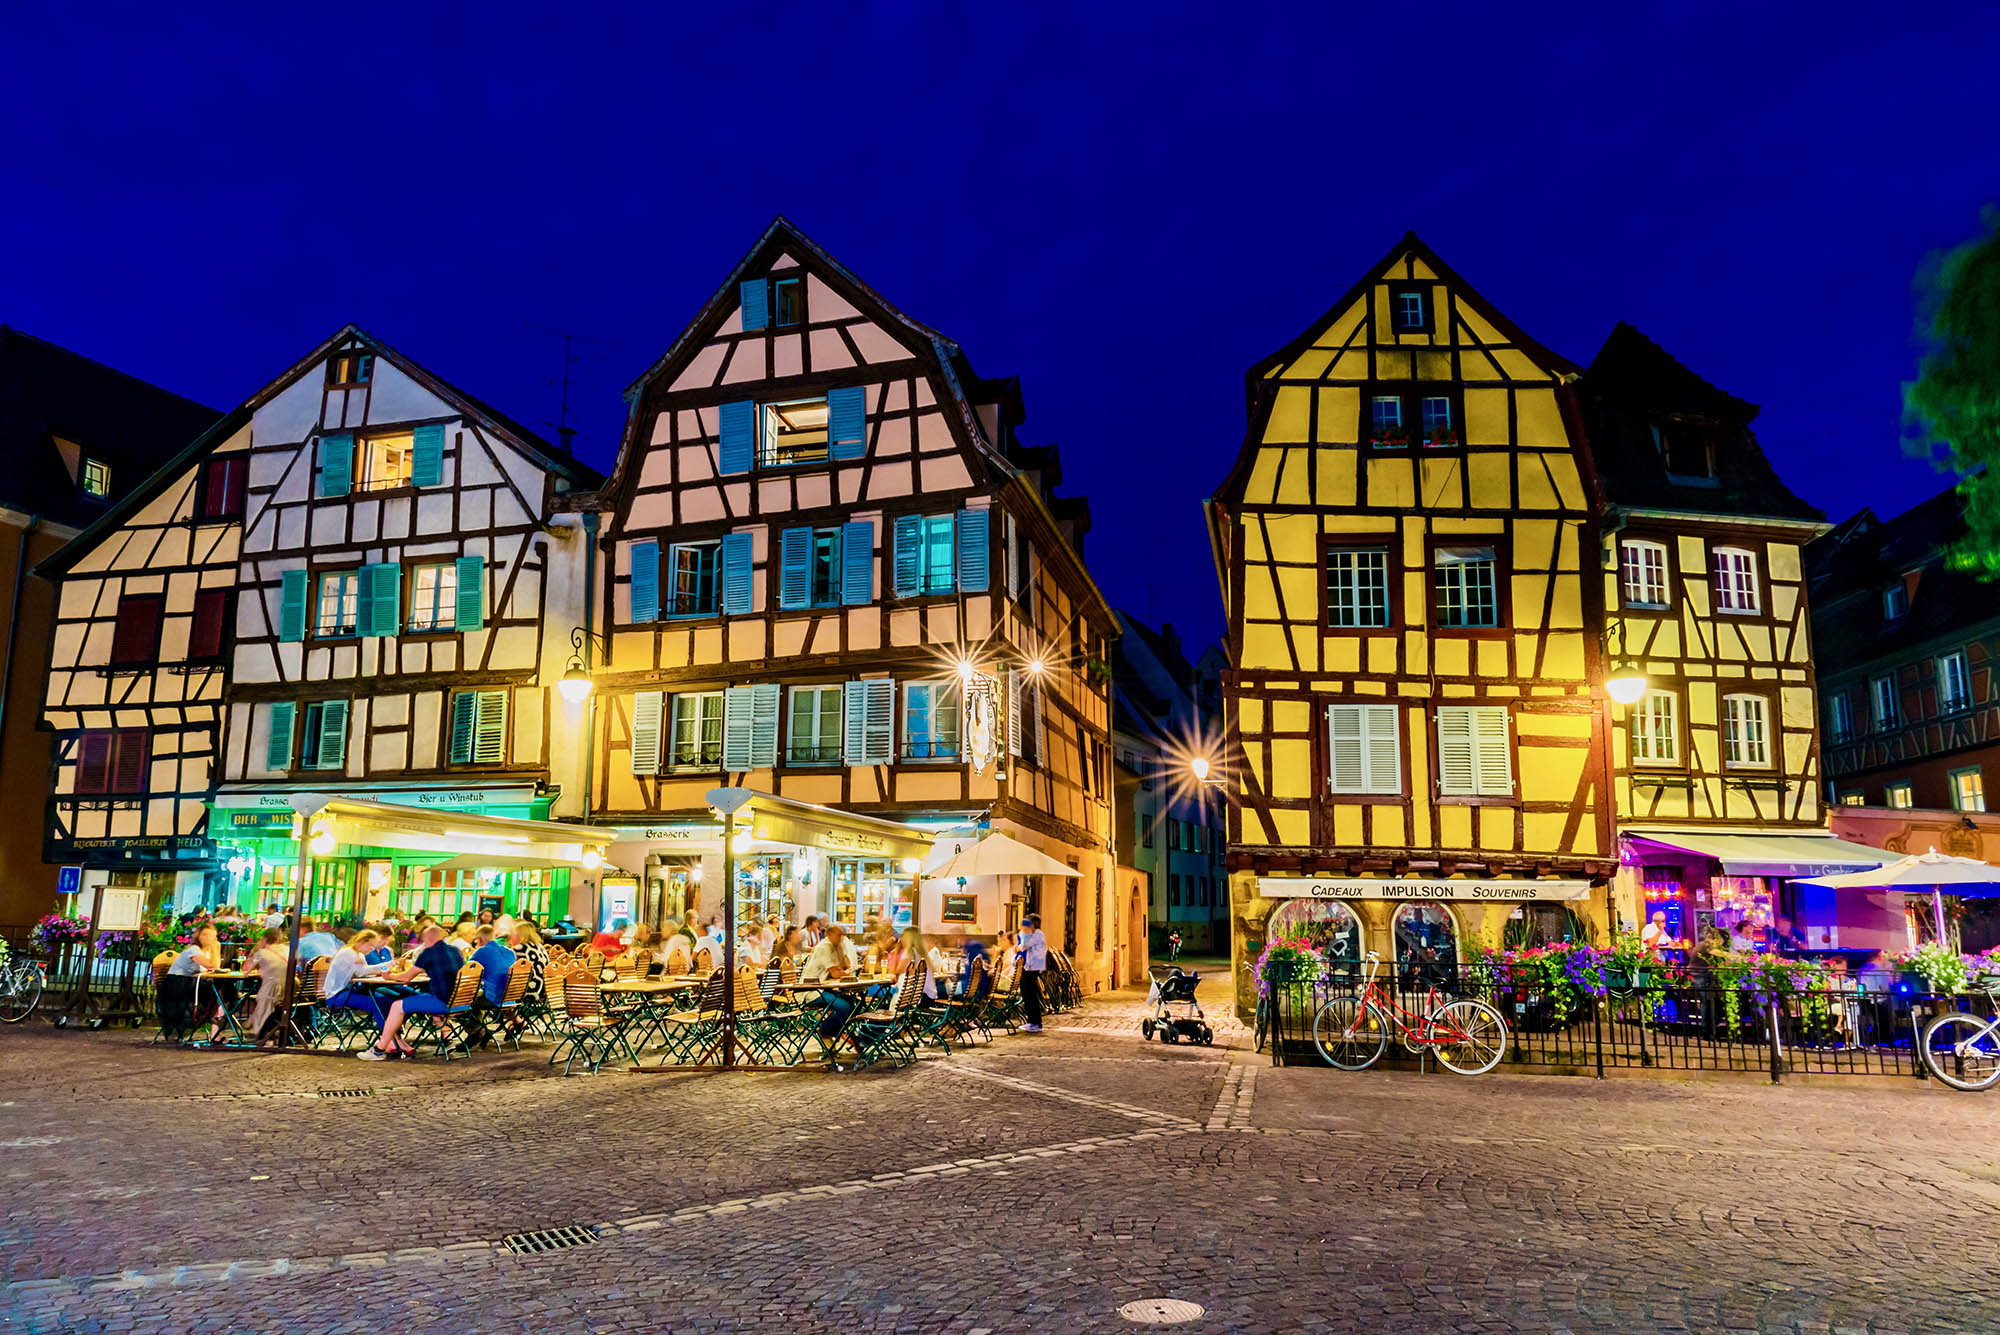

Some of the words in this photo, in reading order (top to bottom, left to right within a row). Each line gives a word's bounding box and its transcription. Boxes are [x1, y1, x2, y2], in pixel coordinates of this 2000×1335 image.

[234, 814, 257, 825] BIER
[645, 828, 690, 839] Brasserie
[176, 837, 203, 848] HELD
[1311, 884, 1364, 897] CADEAUX
[1382, 886, 1454, 898] IMPULSION
[1472, 886, 1537, 898] SOUVENIRS
